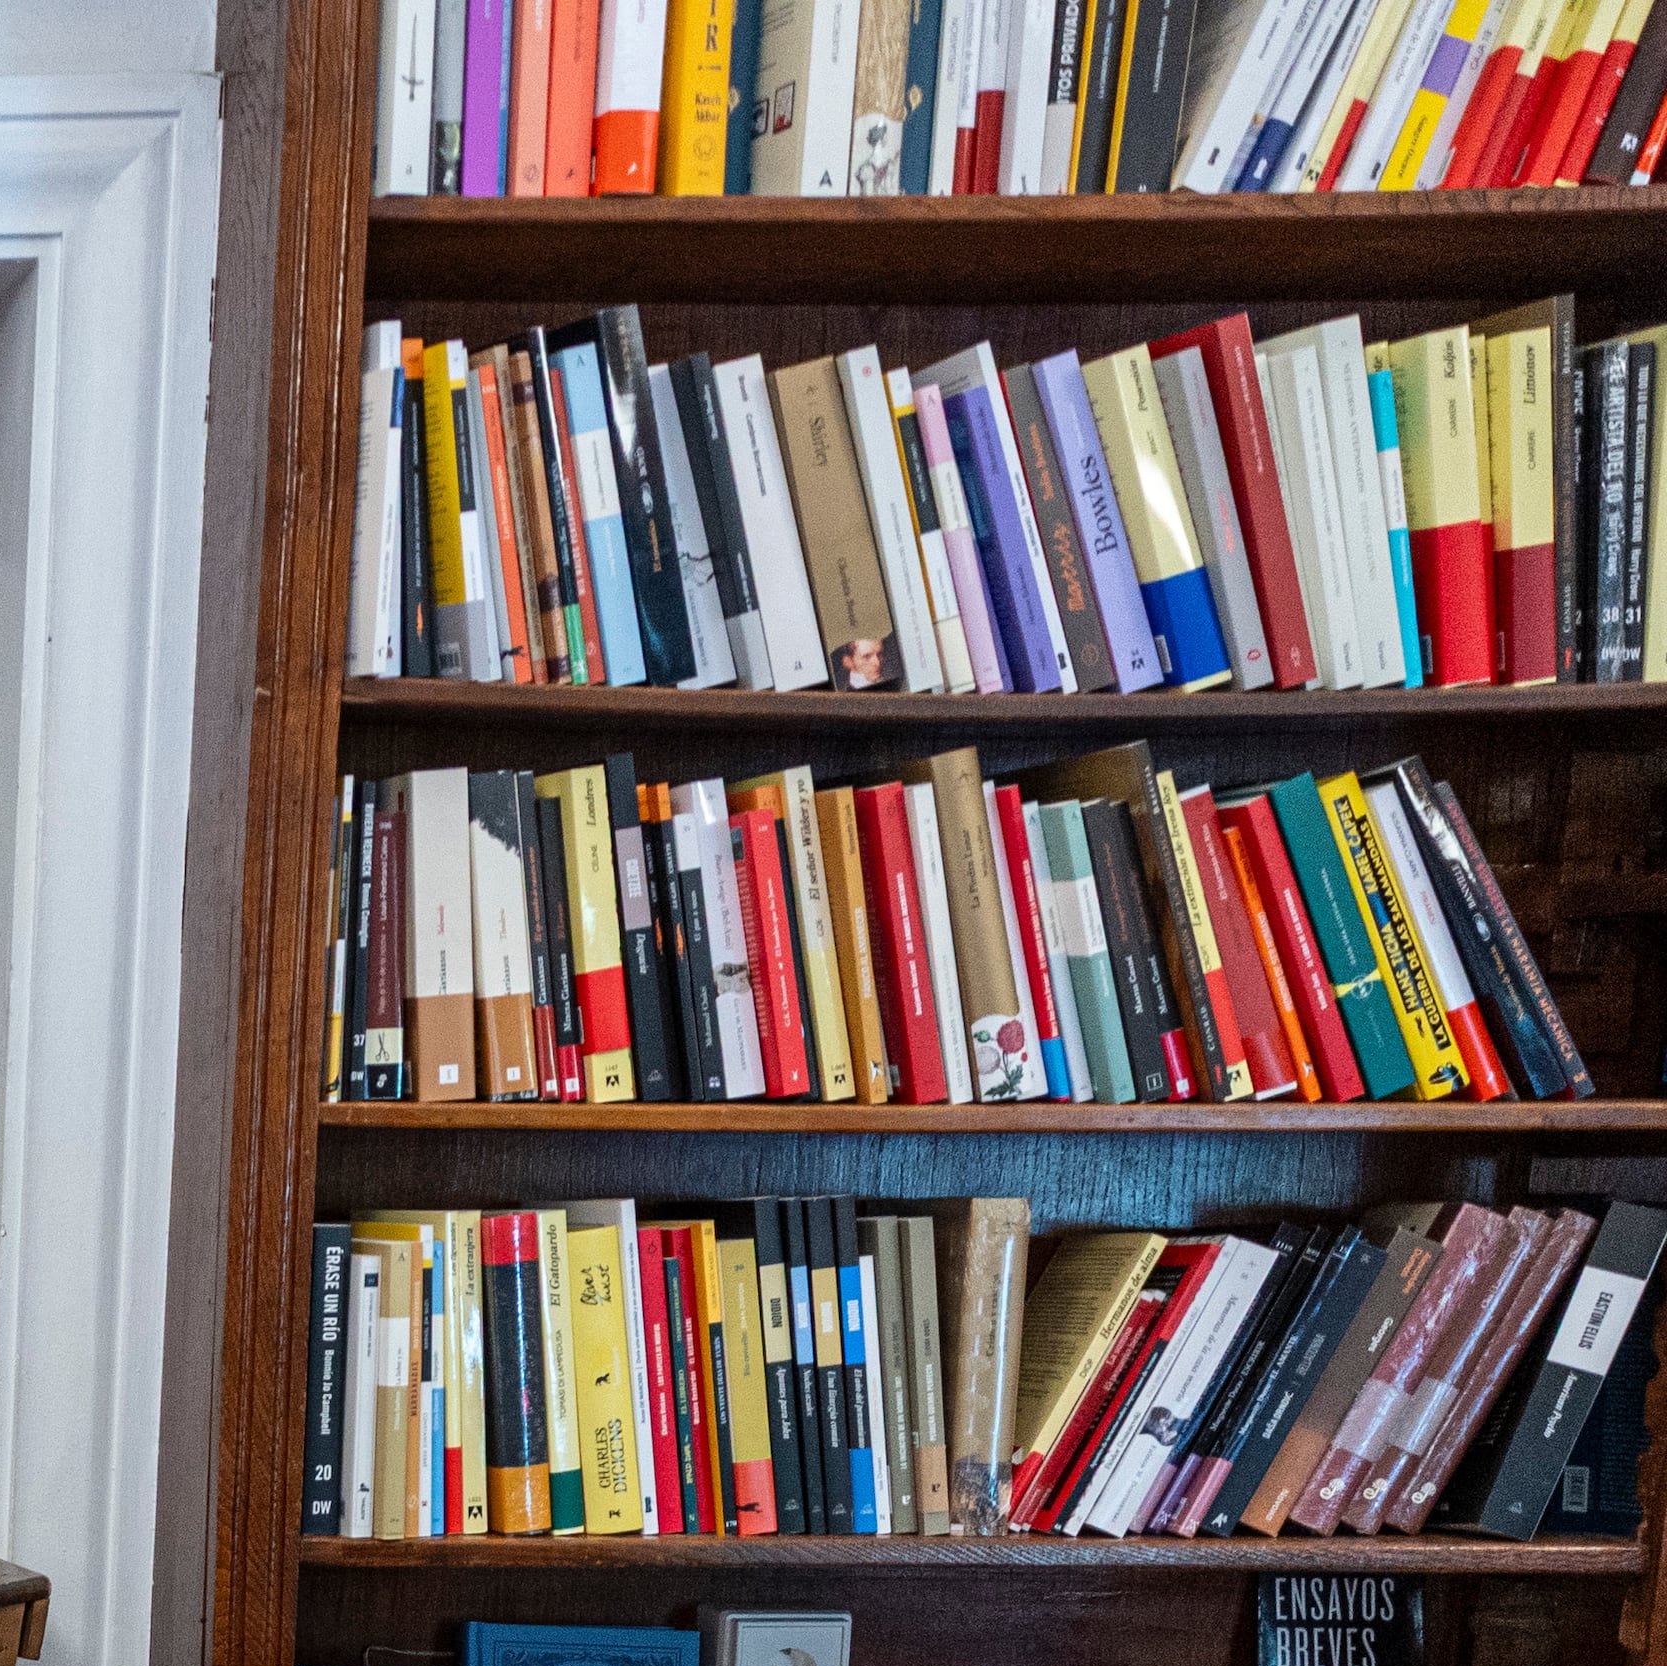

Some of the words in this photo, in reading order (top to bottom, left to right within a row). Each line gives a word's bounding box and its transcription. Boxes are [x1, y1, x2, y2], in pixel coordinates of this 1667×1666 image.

[1524, 344, 1536, 407] Limónov
[1079, 457, 1117, 556] Bowles
[1601, 607, 1620, 623] 38
[1625, 607, 1643, 623] 31
[353, 1034, 365, 1046] 37
[1586, 1289, 1614, 1329] EASTON
[1576, 1323, 1600, 1352] ELLIS
[322, 1348, 335, 1382] Bonnie
[321, 1380, 333, 1393] Jo
[319, 1391, 333, 1435] Campbell
[315, 1465, 332, 1481] 20
[312, 1501, 332, 1515] DW
[1275, 1577, 1396, 1622] ENSAYOS
